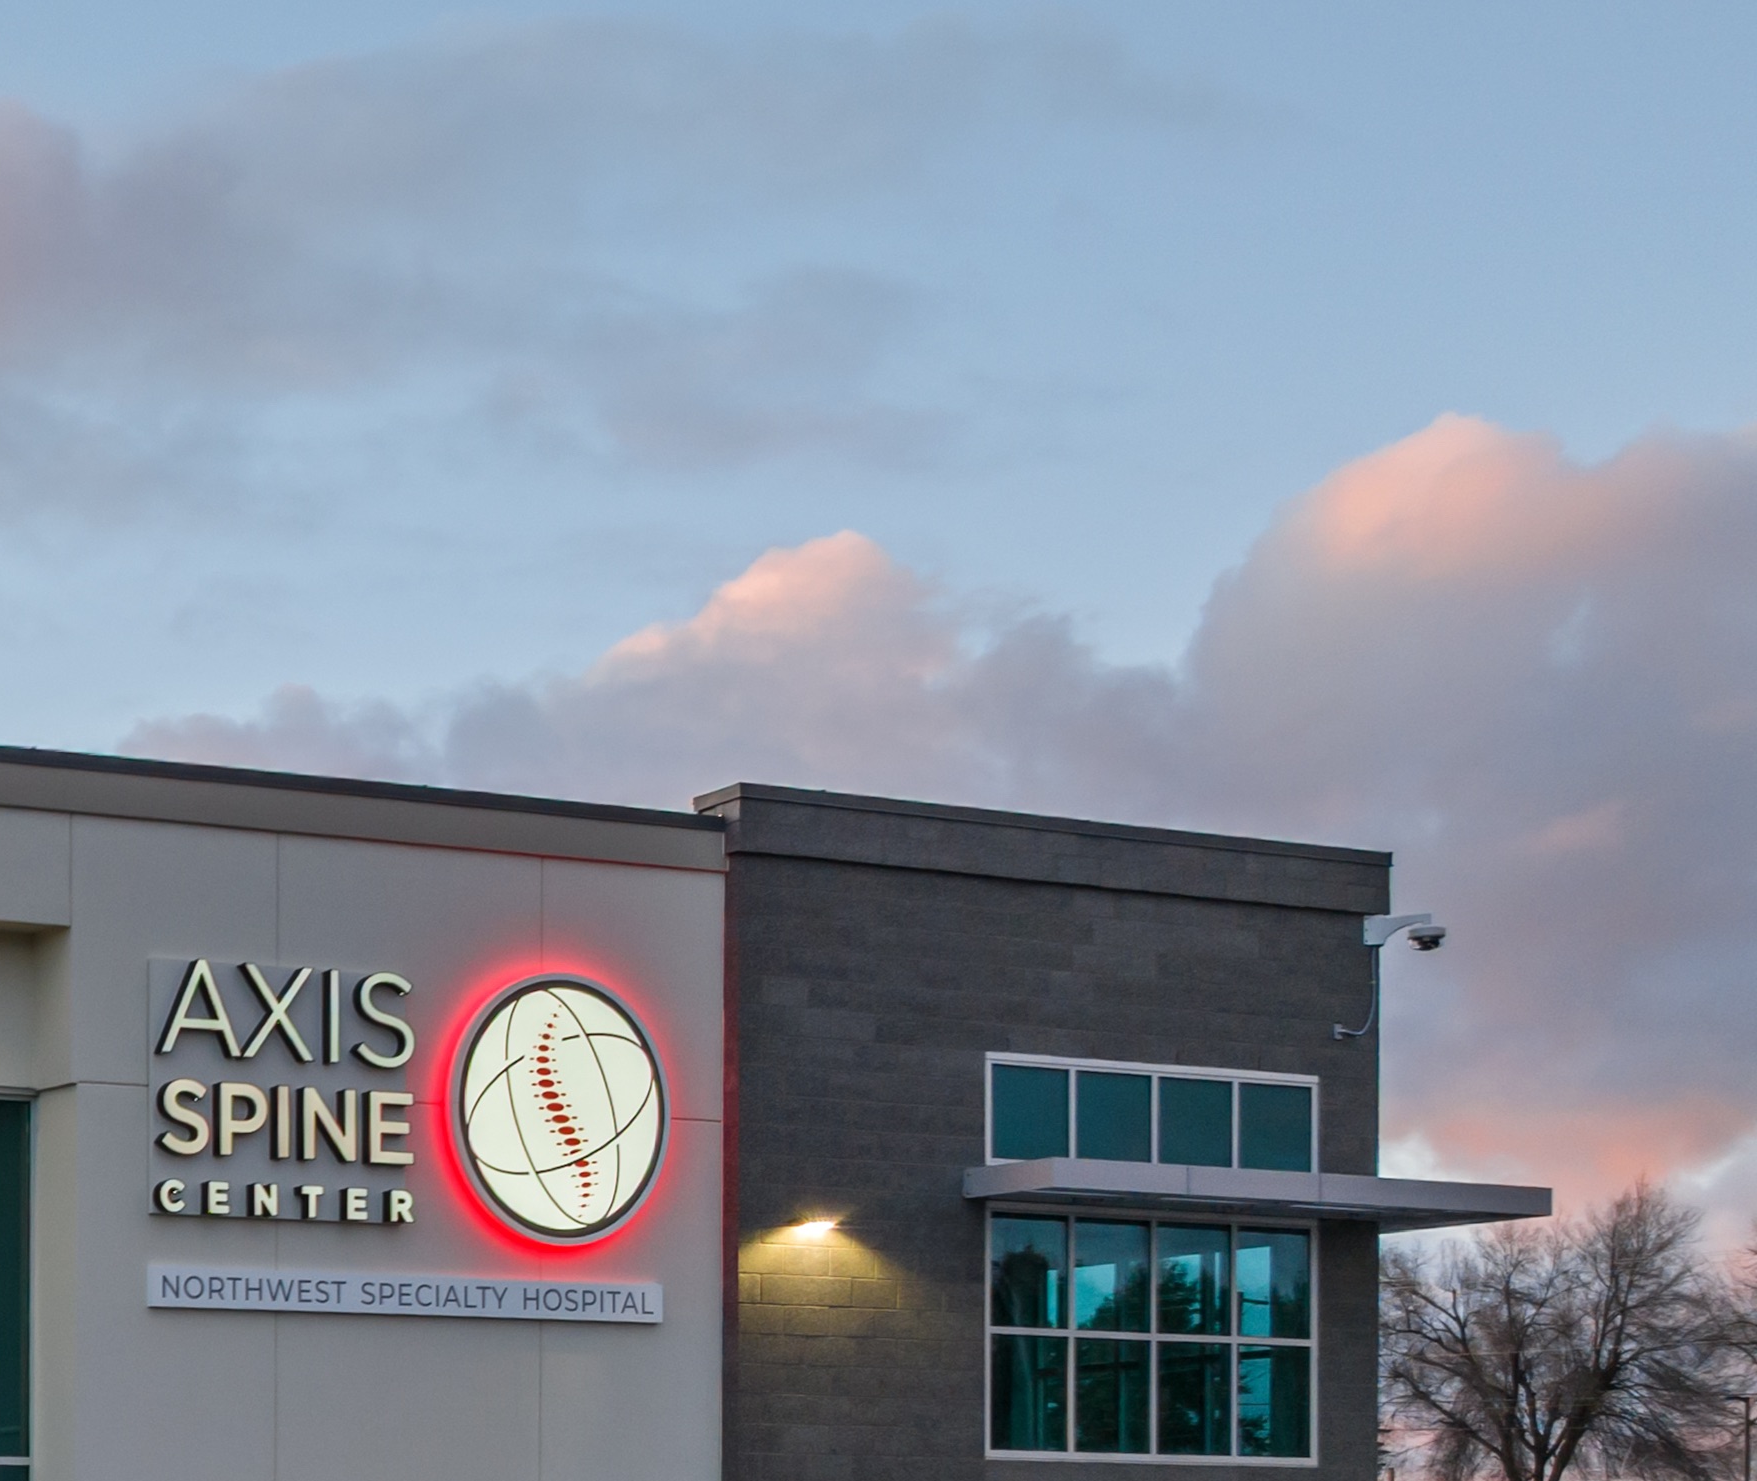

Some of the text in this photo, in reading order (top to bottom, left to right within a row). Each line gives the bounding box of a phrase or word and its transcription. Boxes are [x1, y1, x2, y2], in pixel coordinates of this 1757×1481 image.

[155, 958, 415, 1068] AXIS
[155, 1078, 414, 1164] SPINE
[154, 1178, 414, 1222] CENTER
[161, 1275, 654, 1315] NORTHWEST SPECIALTY HOSPITAL
